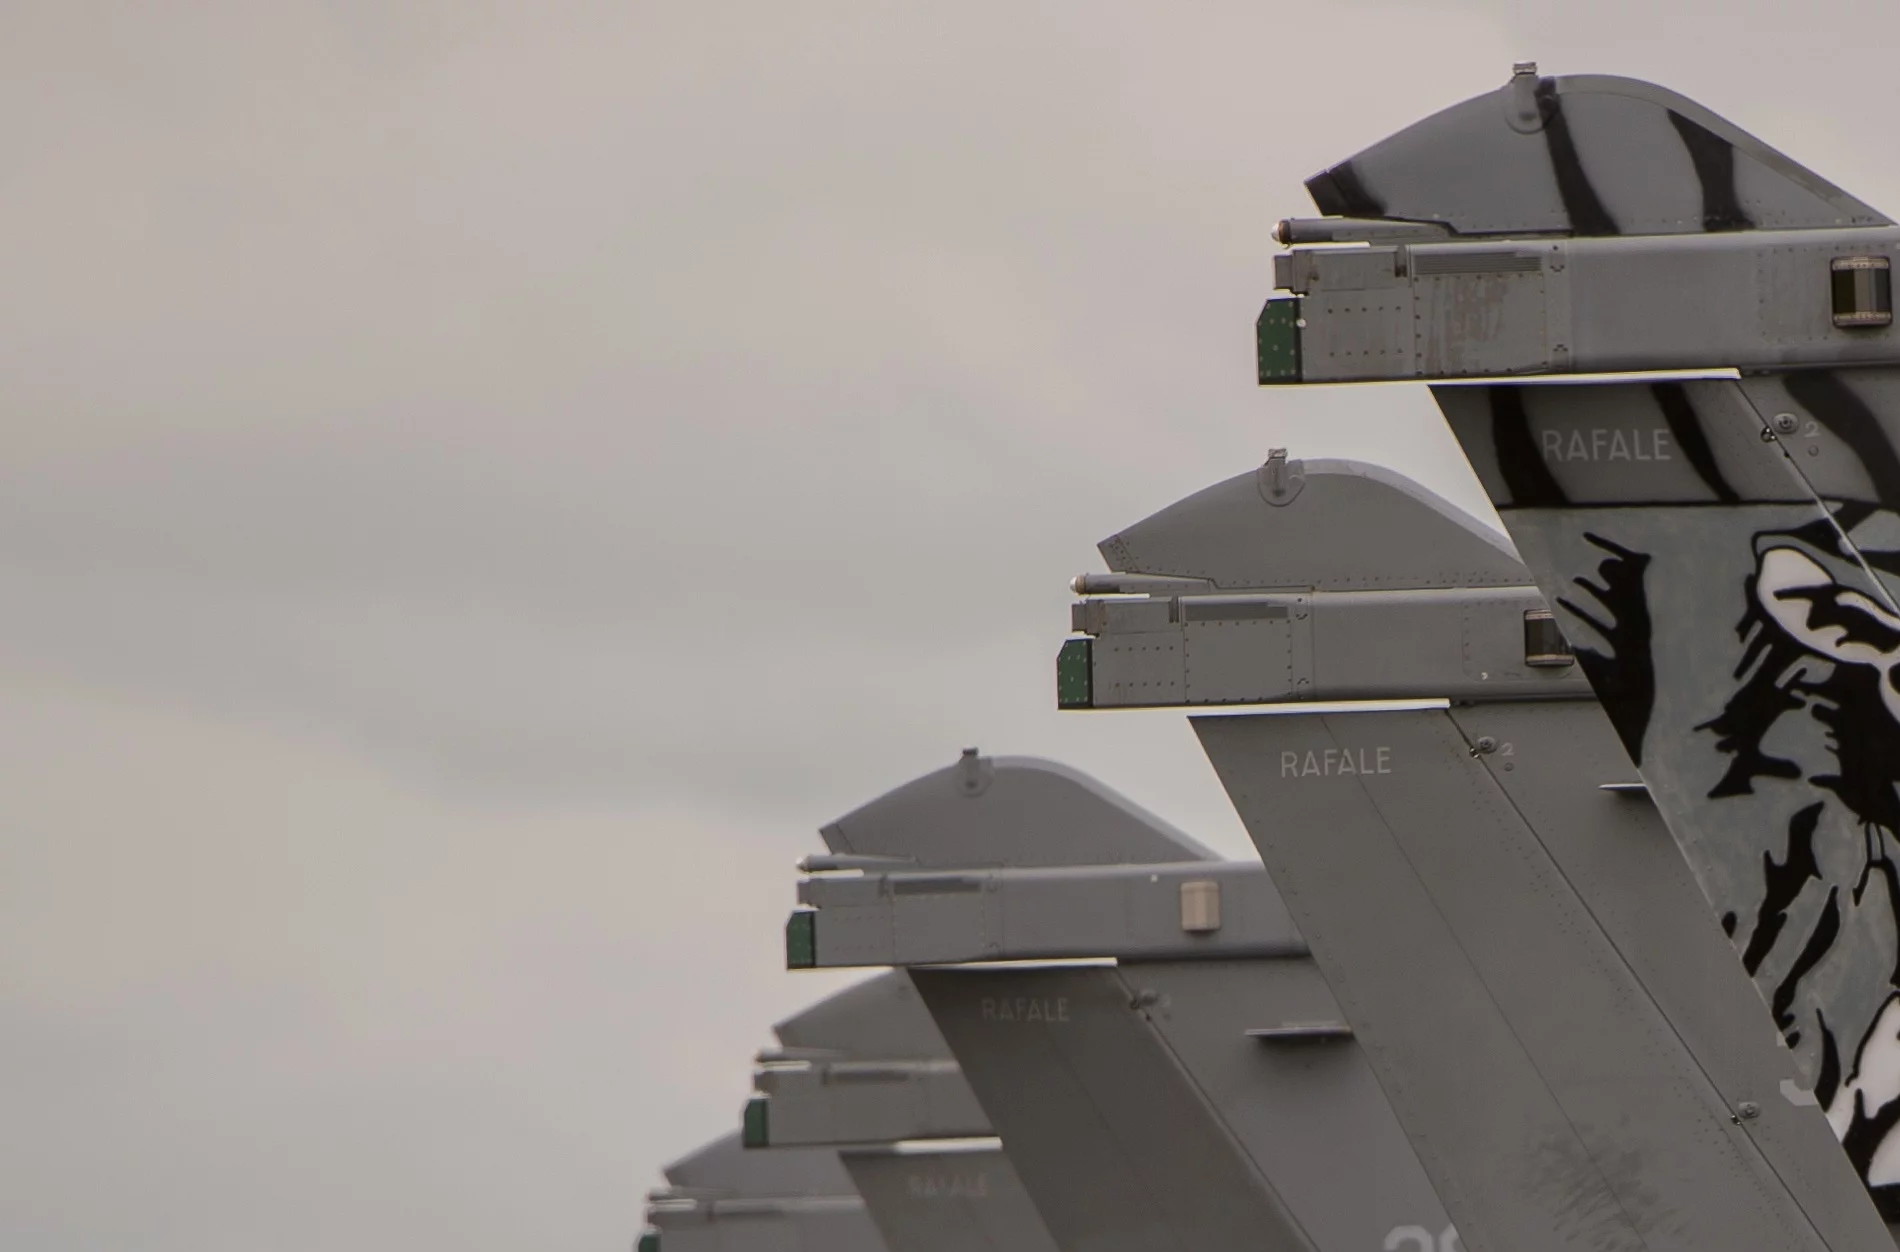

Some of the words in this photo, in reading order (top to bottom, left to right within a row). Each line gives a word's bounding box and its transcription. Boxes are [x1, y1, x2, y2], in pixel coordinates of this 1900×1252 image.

[1804, 421, 1820, 438] 2
[1542, 428, 1672, 462] RAFALE
[1281, 746, 1392, 778] RAFALE
[1501, 742, 1515, 757] 2
[981, 996, 1070, 1022] RAFALE
